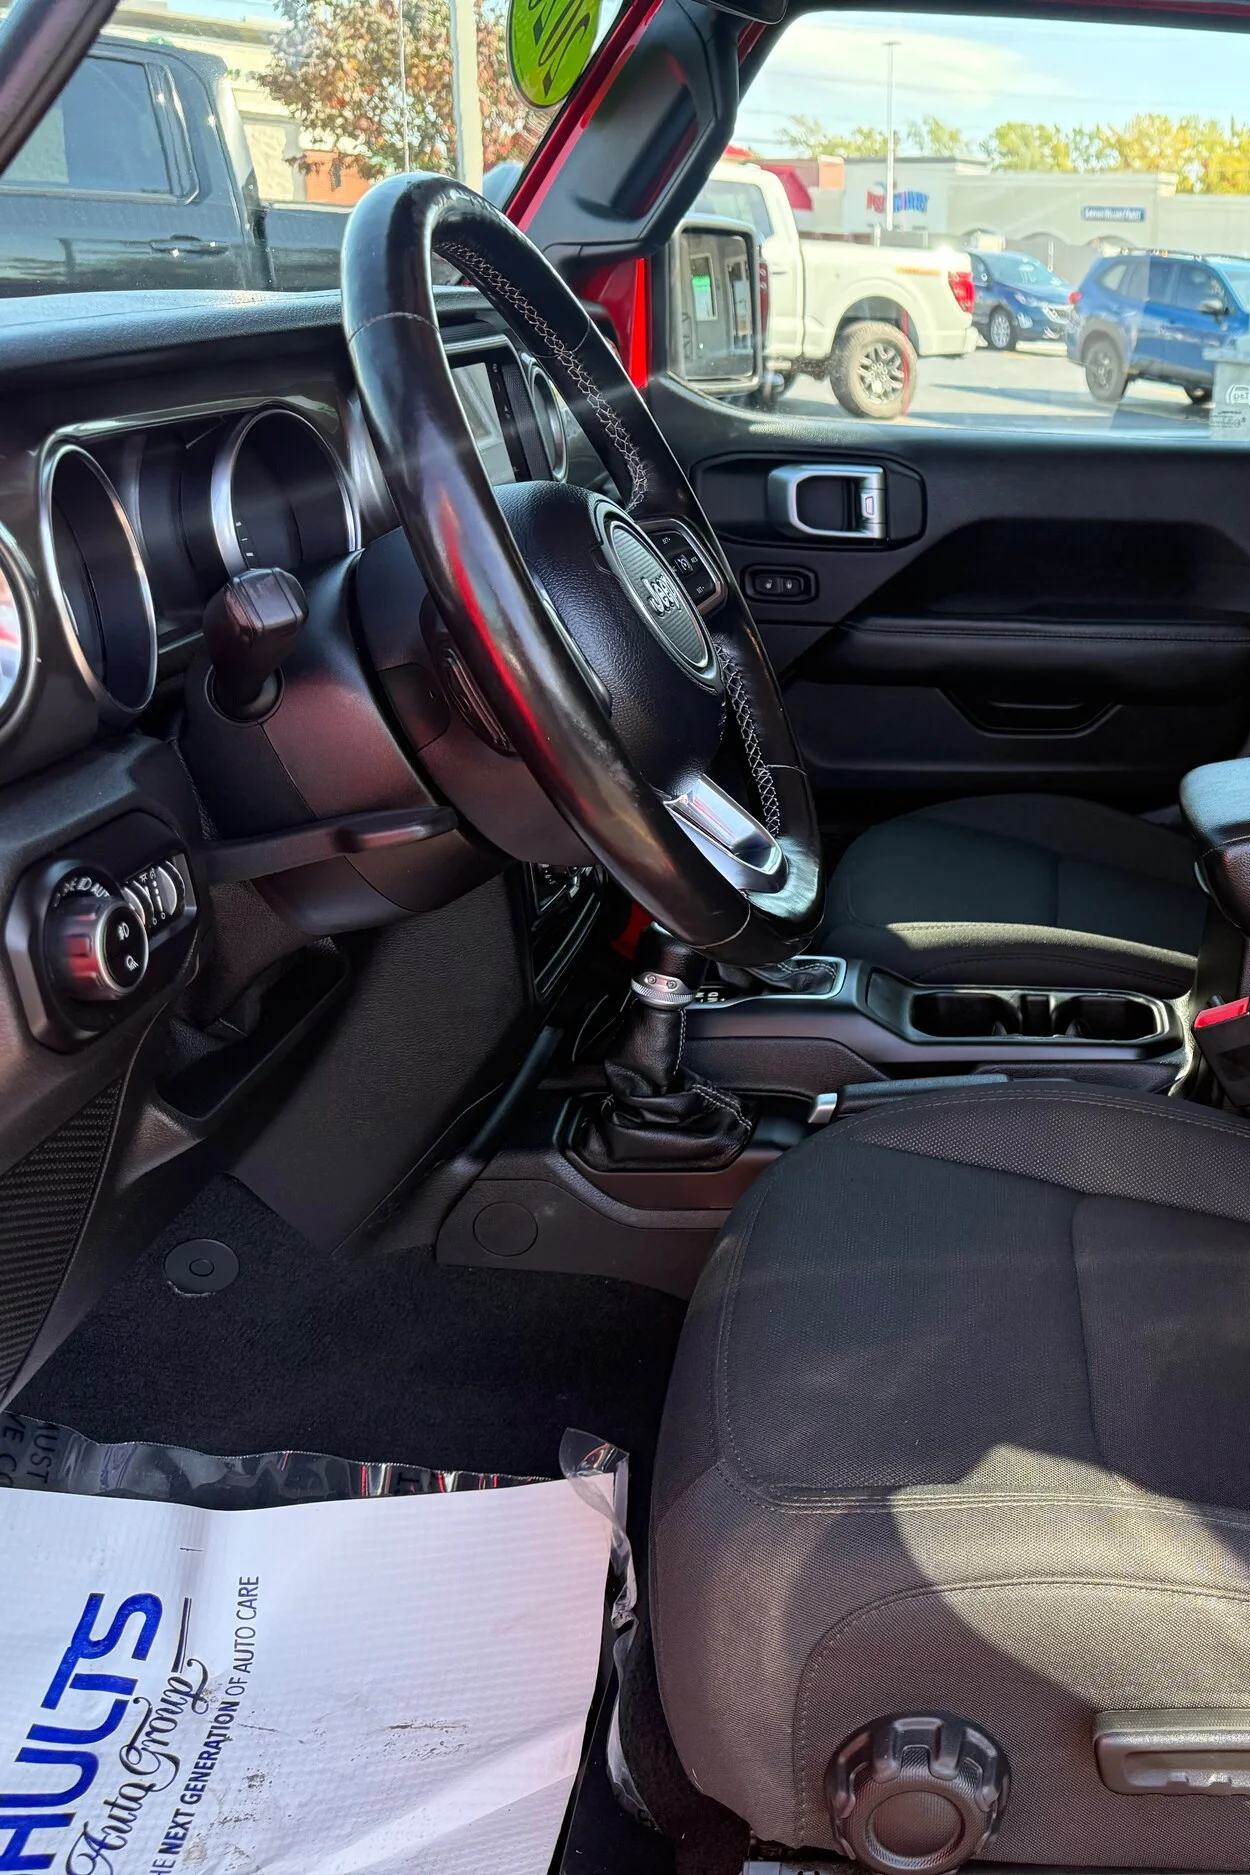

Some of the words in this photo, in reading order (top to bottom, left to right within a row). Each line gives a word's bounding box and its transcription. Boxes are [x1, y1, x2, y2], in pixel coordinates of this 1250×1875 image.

[641, 575, 681, 617] Jeep
[91, 884, 110, 898] AUT
[235, 1575, 260, 1621] CARE
[232, 1625, 258, 1674] AUTO
[225, 1676, 249, 1697] OF
[119, 1658, 209, 1793] Group
[179, 1700, 242, 1806] GENERATION
[157, 1807, 197, 1856] NEXT
